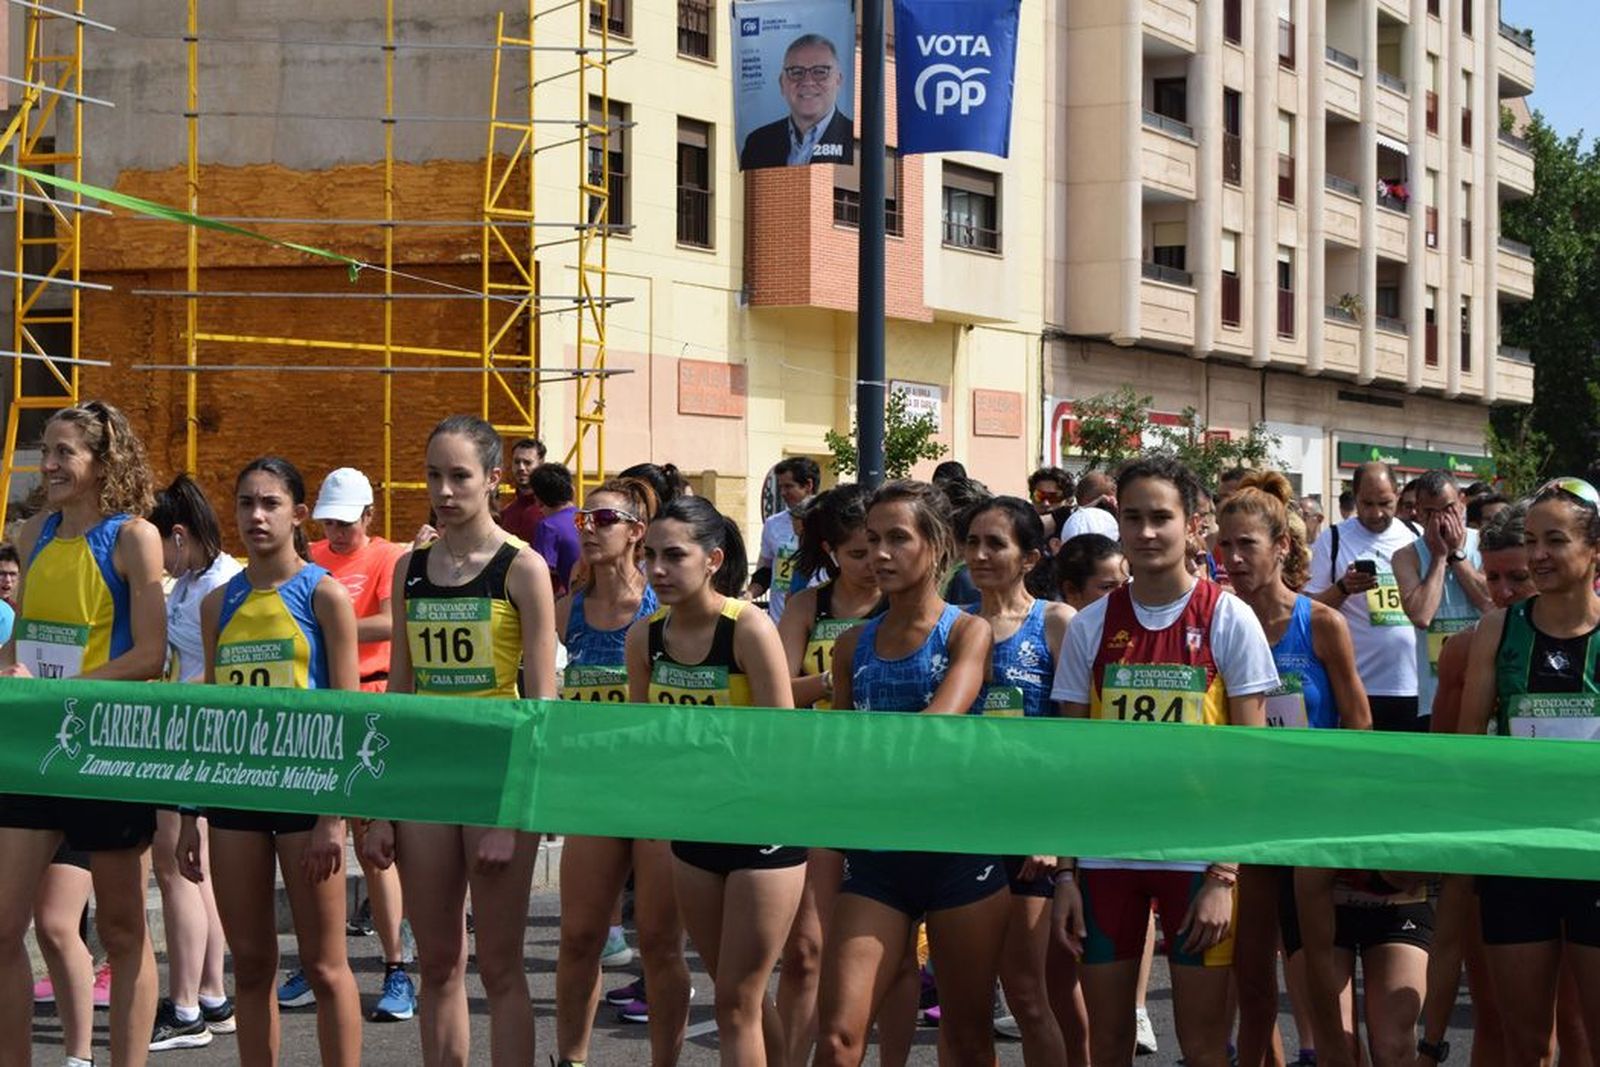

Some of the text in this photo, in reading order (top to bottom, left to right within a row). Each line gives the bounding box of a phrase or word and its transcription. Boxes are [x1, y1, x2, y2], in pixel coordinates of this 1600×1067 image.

[916, 35, 992, 57] VOTA
[813, 144, 843, 157] 28M
[780, 561, 790, 578] 2
[1374, 588, 1400, 608] 15
[428, 612, 479, 620] CAJA RURAL
[418, 627, 474, 664] 116
[231, 651, 282, 663] CAJA RURAL
[812, 646, 834, 674] 1
[431, 674, 491, 685] CAJA RURAL
[1133, 679, 1192, 690] CAJA RURAL
[1112, 694, 1184, 723] 184
[1533, 708, 1595, 717] CAJA RURAL
[89, 702, 344, 760] CARRERA del CERCO de ZAMORA
[79, 753, 339, 796] Zamora cerca de la Esclerosis Múltiple
